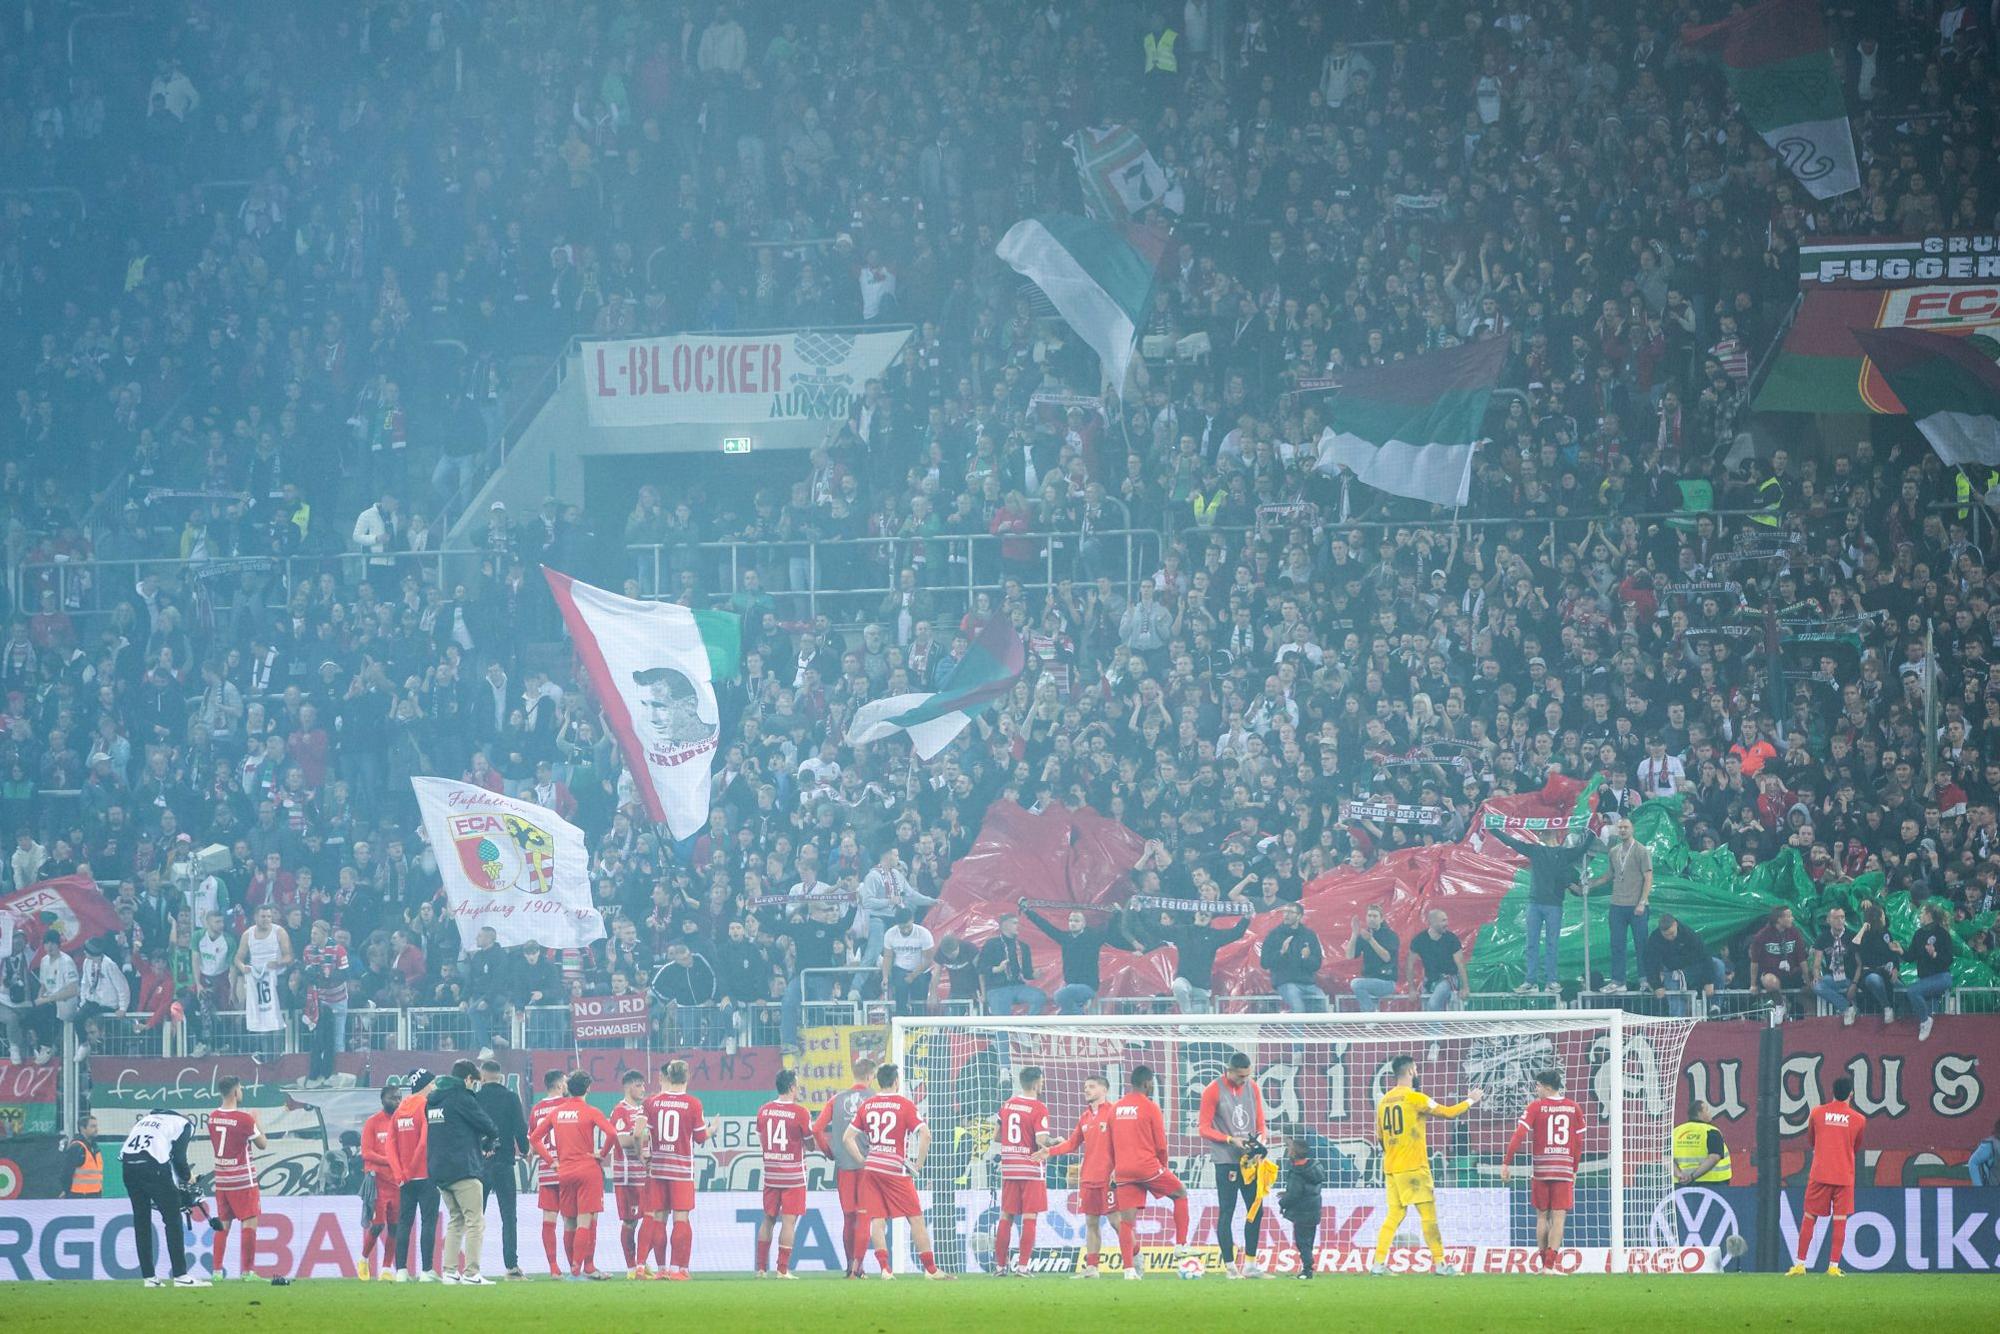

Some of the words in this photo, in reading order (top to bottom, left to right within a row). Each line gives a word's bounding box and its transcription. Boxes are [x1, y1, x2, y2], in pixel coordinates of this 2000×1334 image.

[1923, 236, 2000, 253] GRU
[1904, 289, 2000, 319] FC
[596, 343, 783, 397] L-BLOCKER
[455, 816, 504, 835] FCA
[1397, 810, 1415, 819] DER
[14, 891, 54, 913] FCA
[1155, 899, 1189, 911] LEGIO
[1191, 900, 1249, 913] AUGUSTA
[256, 981, 271, 1005] 16
[576, 1022, 646, 1038] SCHWABEN
[557, 1110, 579, 1119] WWK
[1115, 1105, 1138, 1116] WWK
[1382, 1103, 1404, 1137] 40
[1825, 1112, 1850, 1124] WWK
[657, 1110, 680, 1142] 10
[766, 1119, 789, 1151] 14
[865, 1110, 897, 1144] 32
[1007, 1112, 1022, 1144] 6
[1547, 1114, 1570, 1145] 13
[215, 1126, 228, 1157] 7
[1778, 1187, 2000, 1271] Volk
